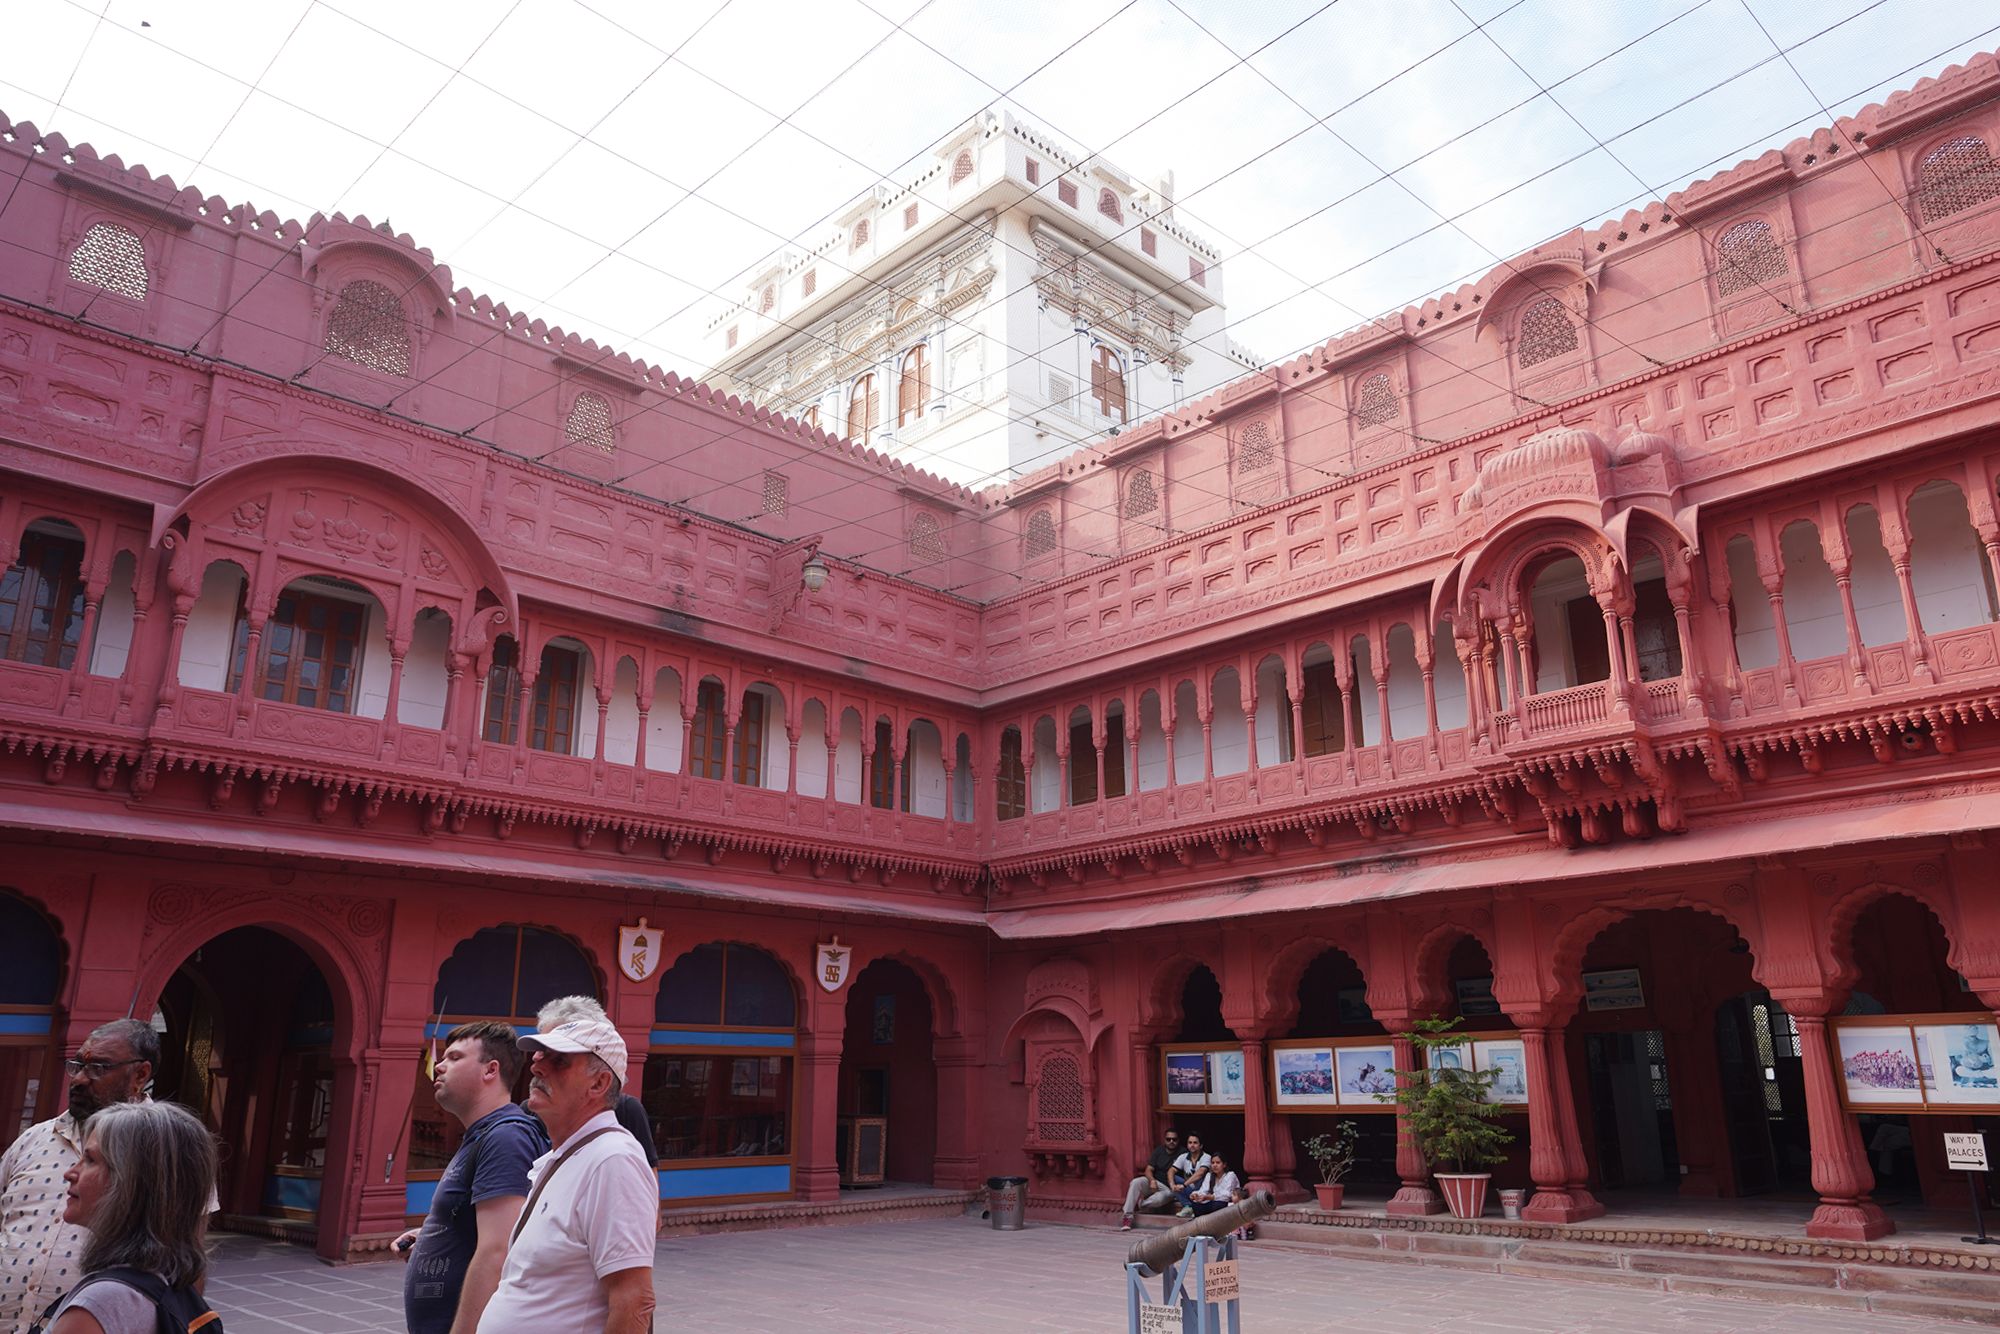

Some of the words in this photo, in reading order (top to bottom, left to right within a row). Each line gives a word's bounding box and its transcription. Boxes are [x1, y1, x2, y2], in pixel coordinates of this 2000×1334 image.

[1949, 1136, 1965, 1144] WAY
[1967, 1136, 1978, 1145] TO
[1948, 1148, 1984, 1157] PALACES
[1209, 1266, 1231, 1276] PLEASE
[1220, 1276, 1236, 1284] TOUCH
